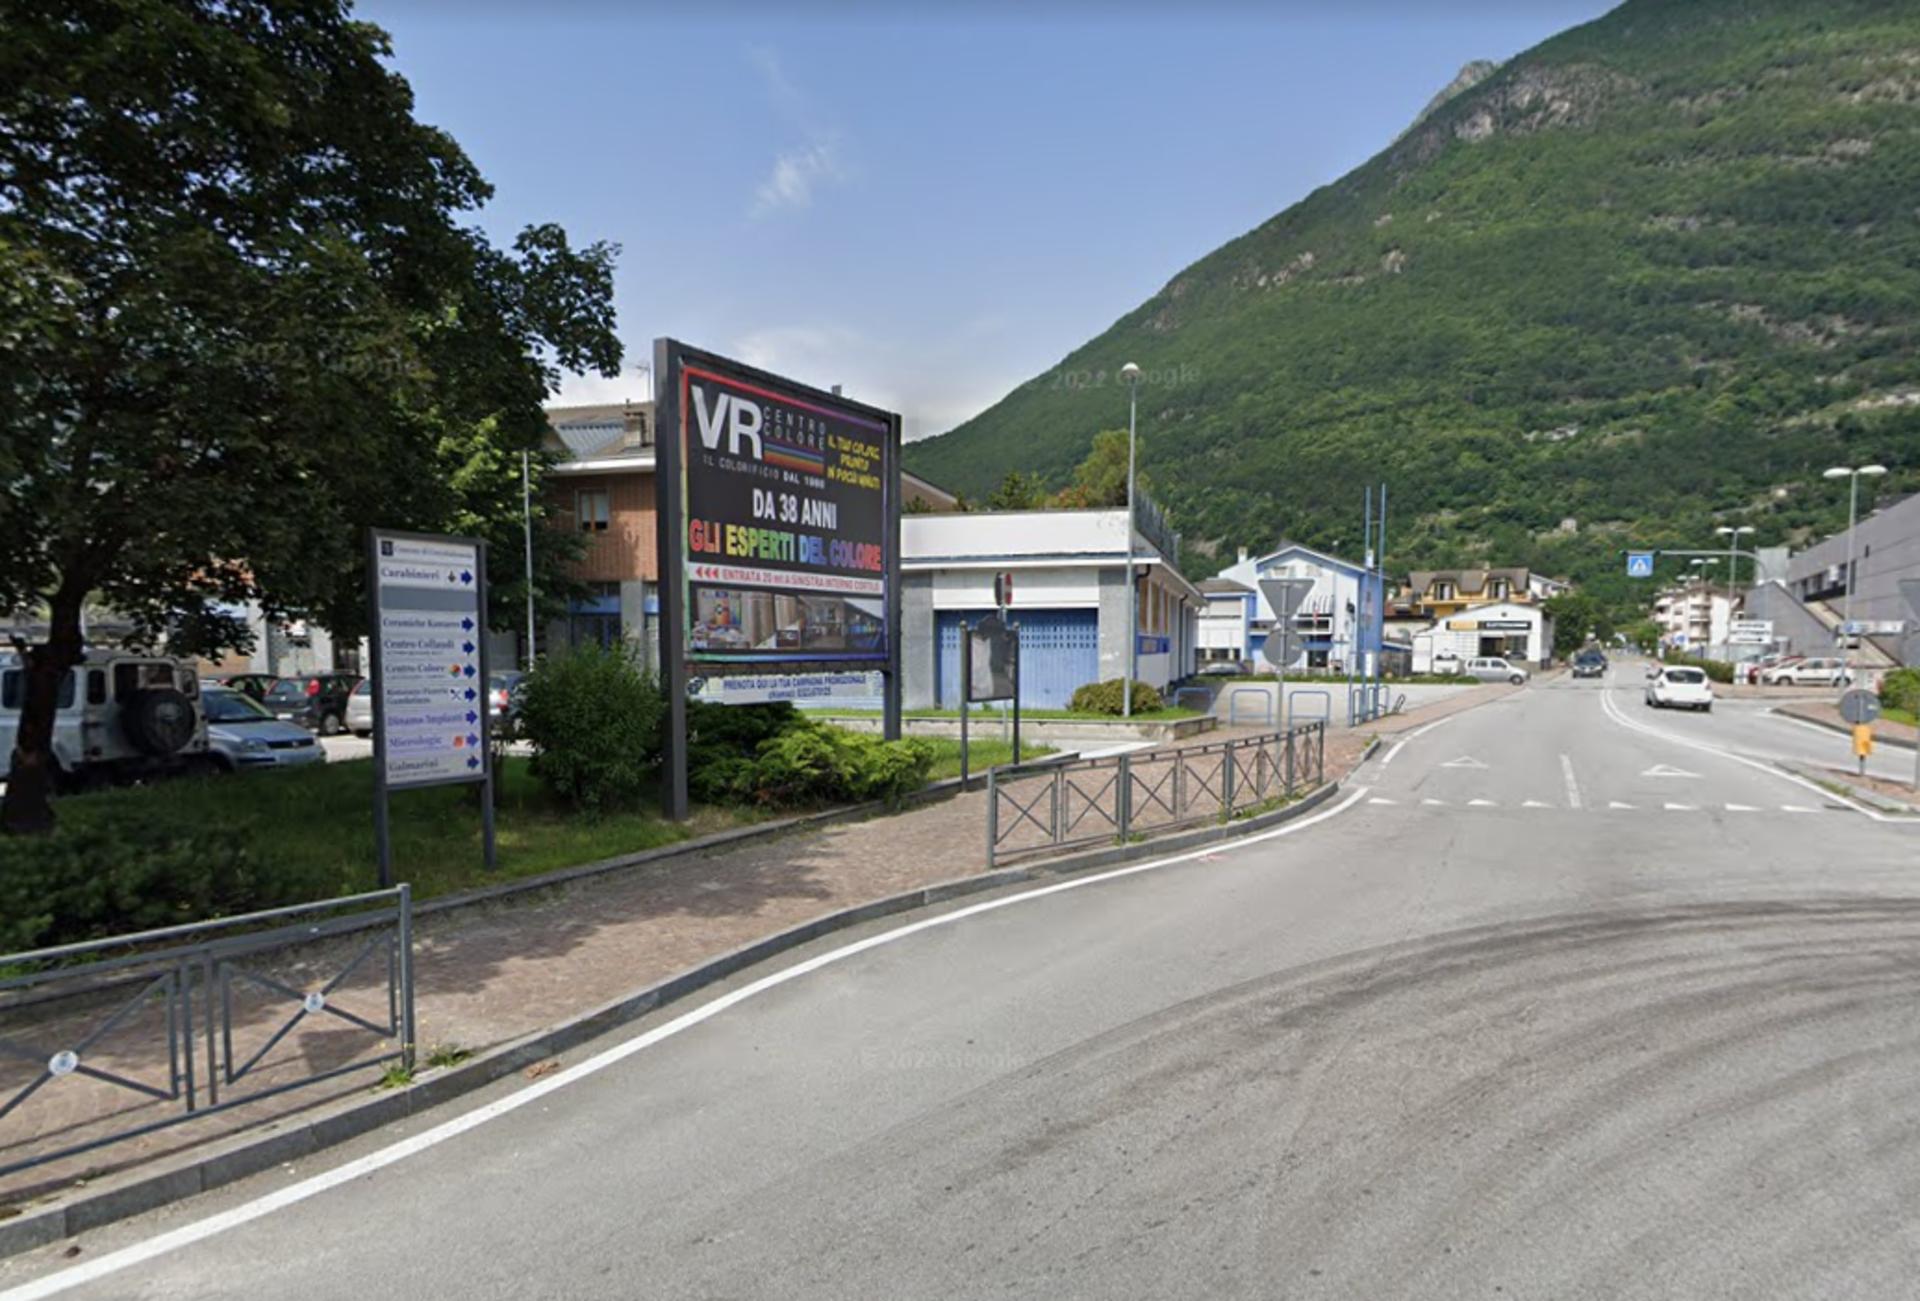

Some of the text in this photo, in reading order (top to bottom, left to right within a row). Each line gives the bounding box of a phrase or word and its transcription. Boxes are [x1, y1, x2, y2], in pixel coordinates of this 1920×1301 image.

[691, 385, 762, 460] VR
[763, 406, 826, 435] CENTRO
[763, 422, 824, 451] COLORE
[702, 454, 714, 467] IL
[718, 458, 779, 481] COLORIFICIO
[783, 472, 800, 486] DAL
[752, 488, 837, 530] DA 38 ANNI
[689, 519, 882, 572] GLI ESPERTI DEL COLORE
[381, 566, 440, 581] Carabinieri
[723, 569, 762, 584] ENTRATA
[791, 574, 824, 588] SINISTRA
[384, 639, 454, 650] Centro Collaudi
[385, 664, 416, 673] Centro
